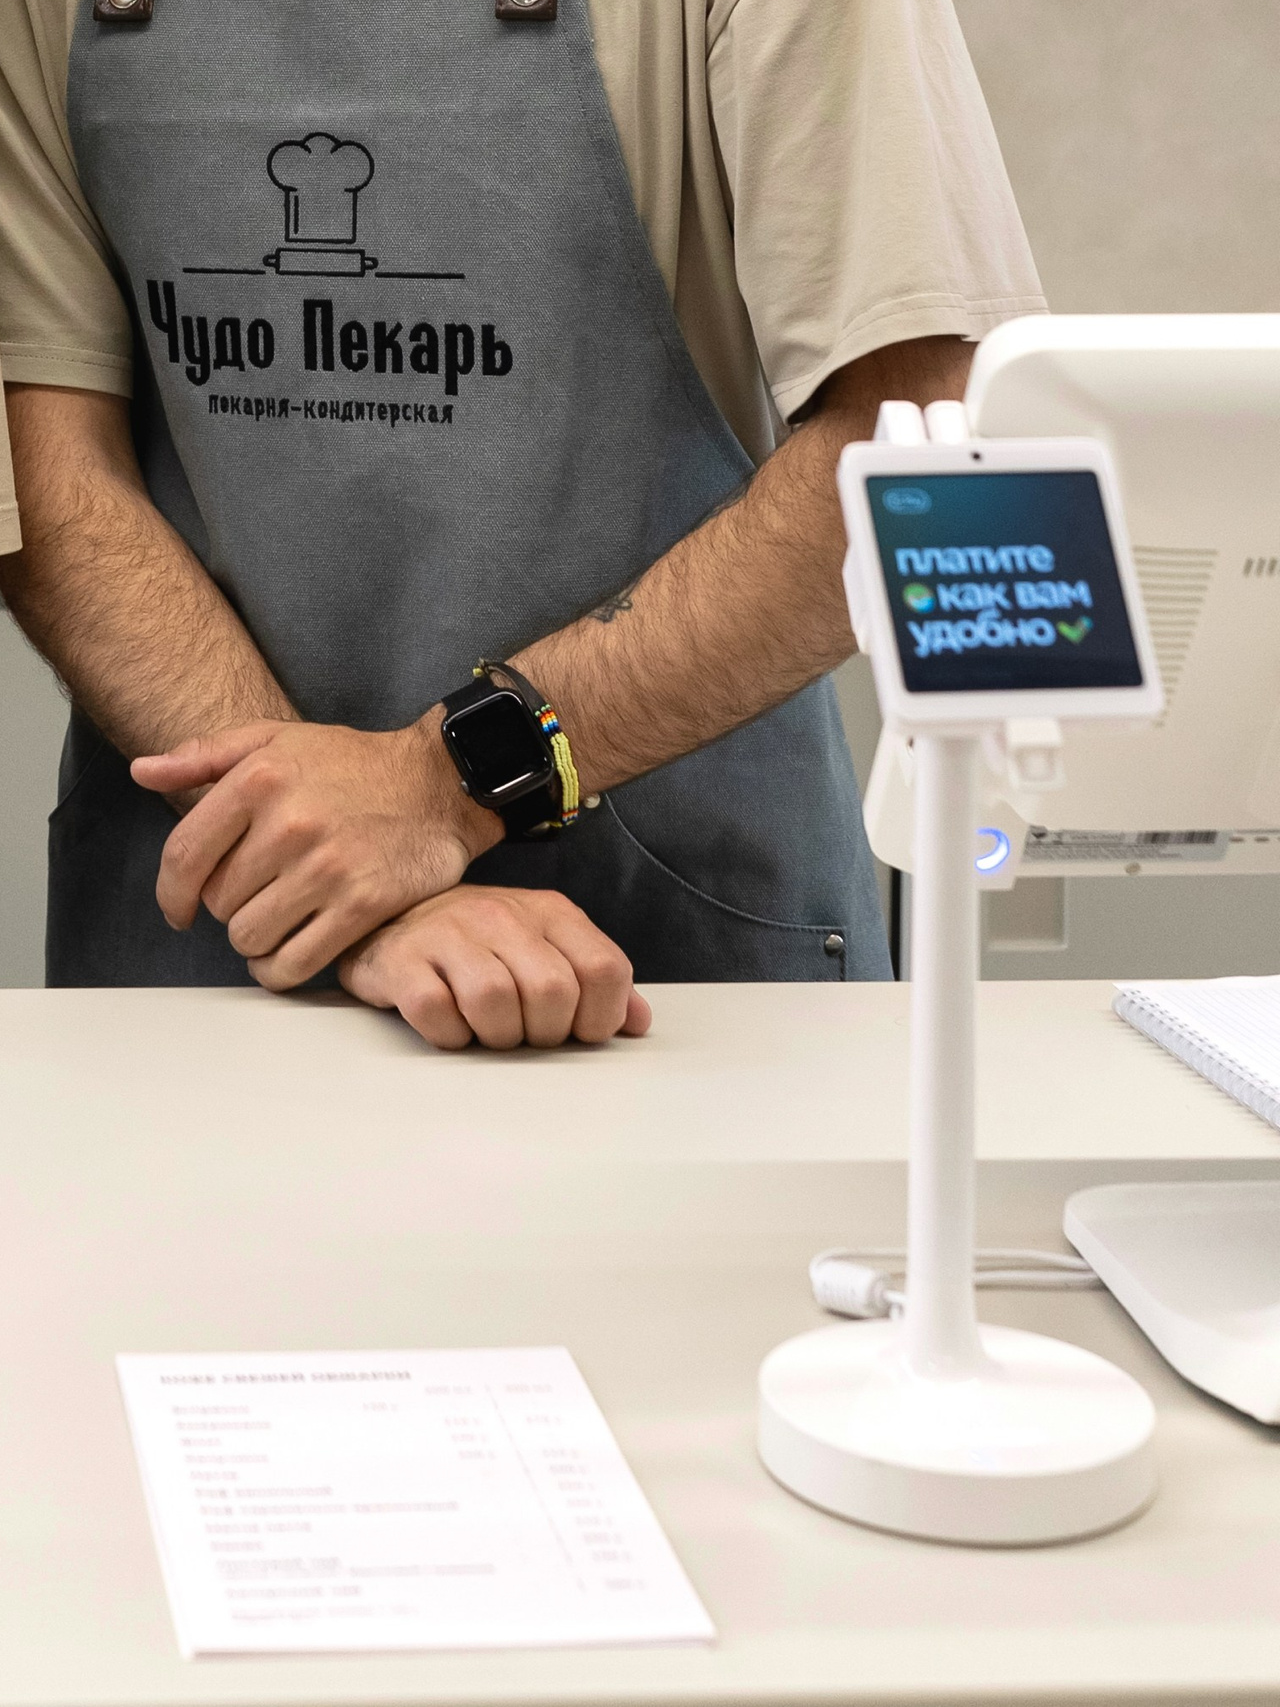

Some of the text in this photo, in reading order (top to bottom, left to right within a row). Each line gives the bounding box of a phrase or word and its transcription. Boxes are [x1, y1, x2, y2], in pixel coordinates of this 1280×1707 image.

[146, 279, 513, 395] Чудо Пекарь
[208, 394, 454, 427] пекарня-кондитерская
[894, 544, 1055, 576] платите
[936, 579, 1093, 611] как вам
[906, 607, 1056, 657] удобно
